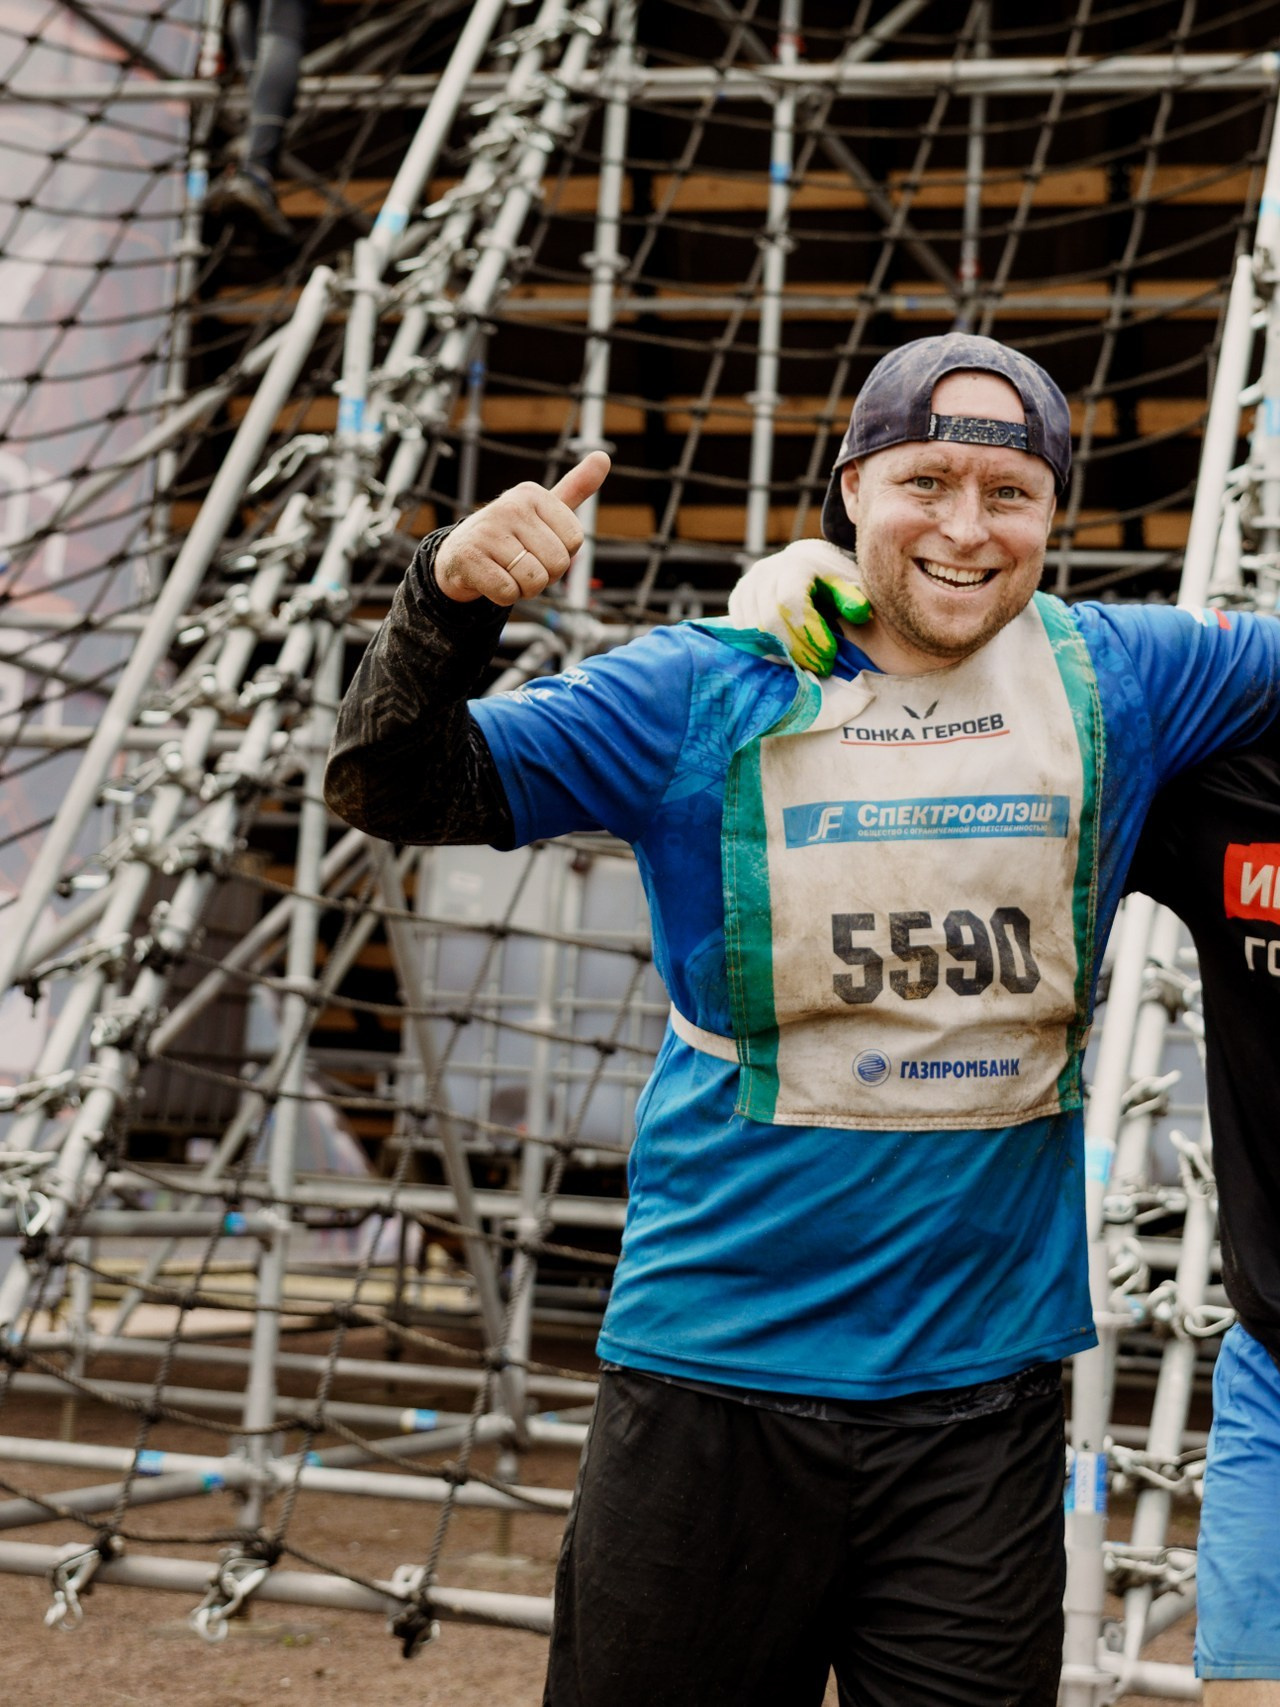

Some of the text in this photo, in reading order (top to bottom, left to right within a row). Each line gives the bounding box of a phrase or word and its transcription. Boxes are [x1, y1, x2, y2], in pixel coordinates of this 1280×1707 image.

[843, 713, 1005, 742] ГОНКА ГЕРОЕВ
[831, 906, 1041, 1004] 5590
[899, 1057, 1020, 1080] ГАЗПРОМБАНК
